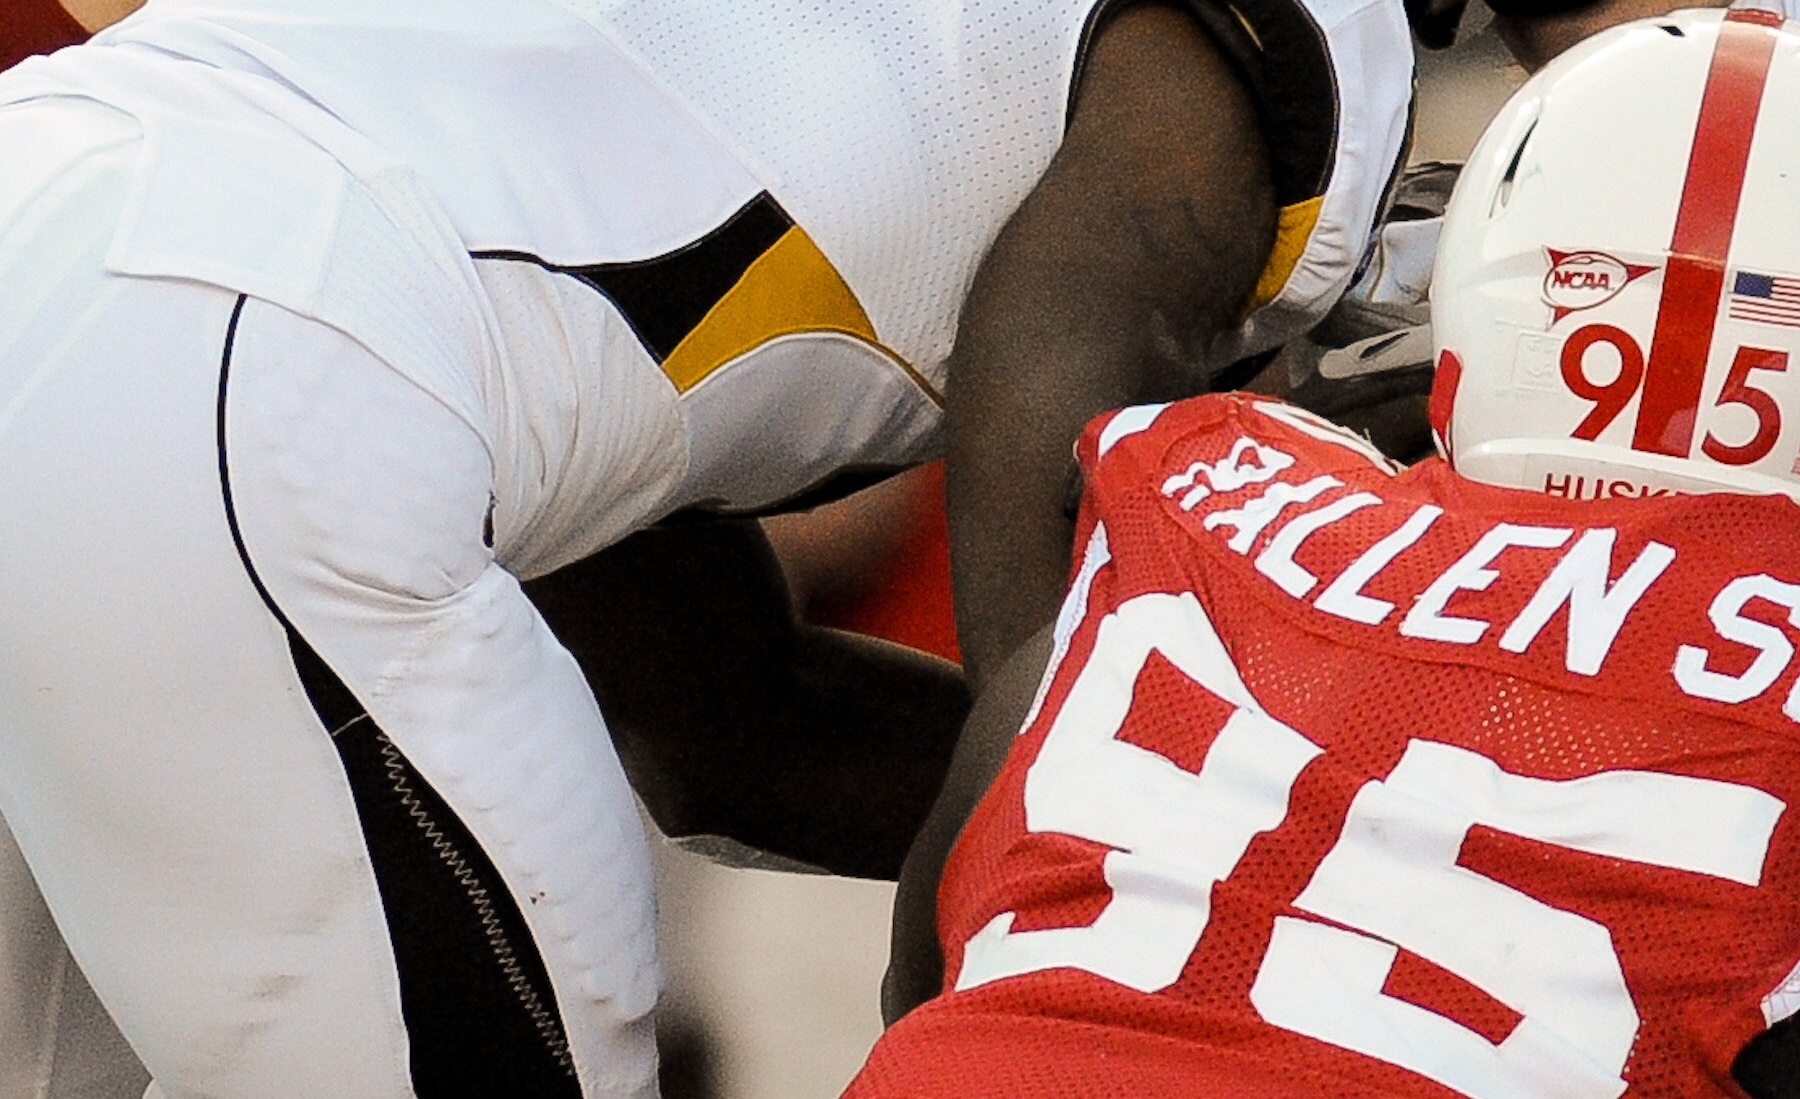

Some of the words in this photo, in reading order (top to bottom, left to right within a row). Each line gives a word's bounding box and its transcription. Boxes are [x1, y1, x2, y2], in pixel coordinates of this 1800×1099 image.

[1552, 270, 1612, 292] NCAA
[1559, 322, 1790, 467] 95
[955, 589, 1786, 1099] 95
